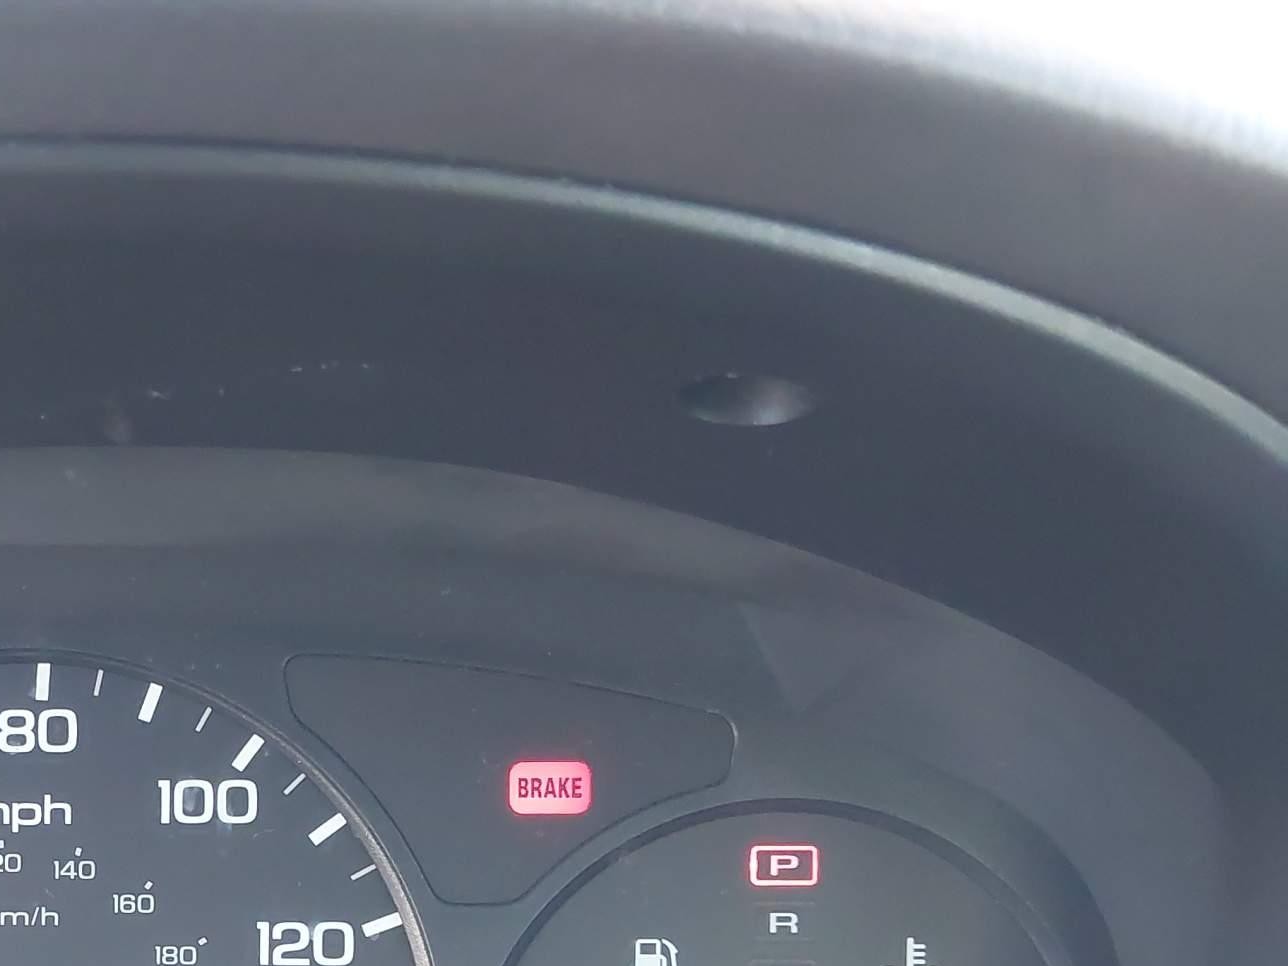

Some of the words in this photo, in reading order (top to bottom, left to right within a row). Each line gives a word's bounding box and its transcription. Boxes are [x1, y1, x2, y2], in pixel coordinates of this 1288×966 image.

[517, 776, 583, 799] BRAKE
[158, 779, 258, 825] 100
[53, 860, 96, 880] 140
[769, 854, 800, 875] P
[112, 894, 155, 914] 160
[768, 912, 800, 933] R
[256, 921, 355, 966] 120
[154, 945, 198, 965] 180
